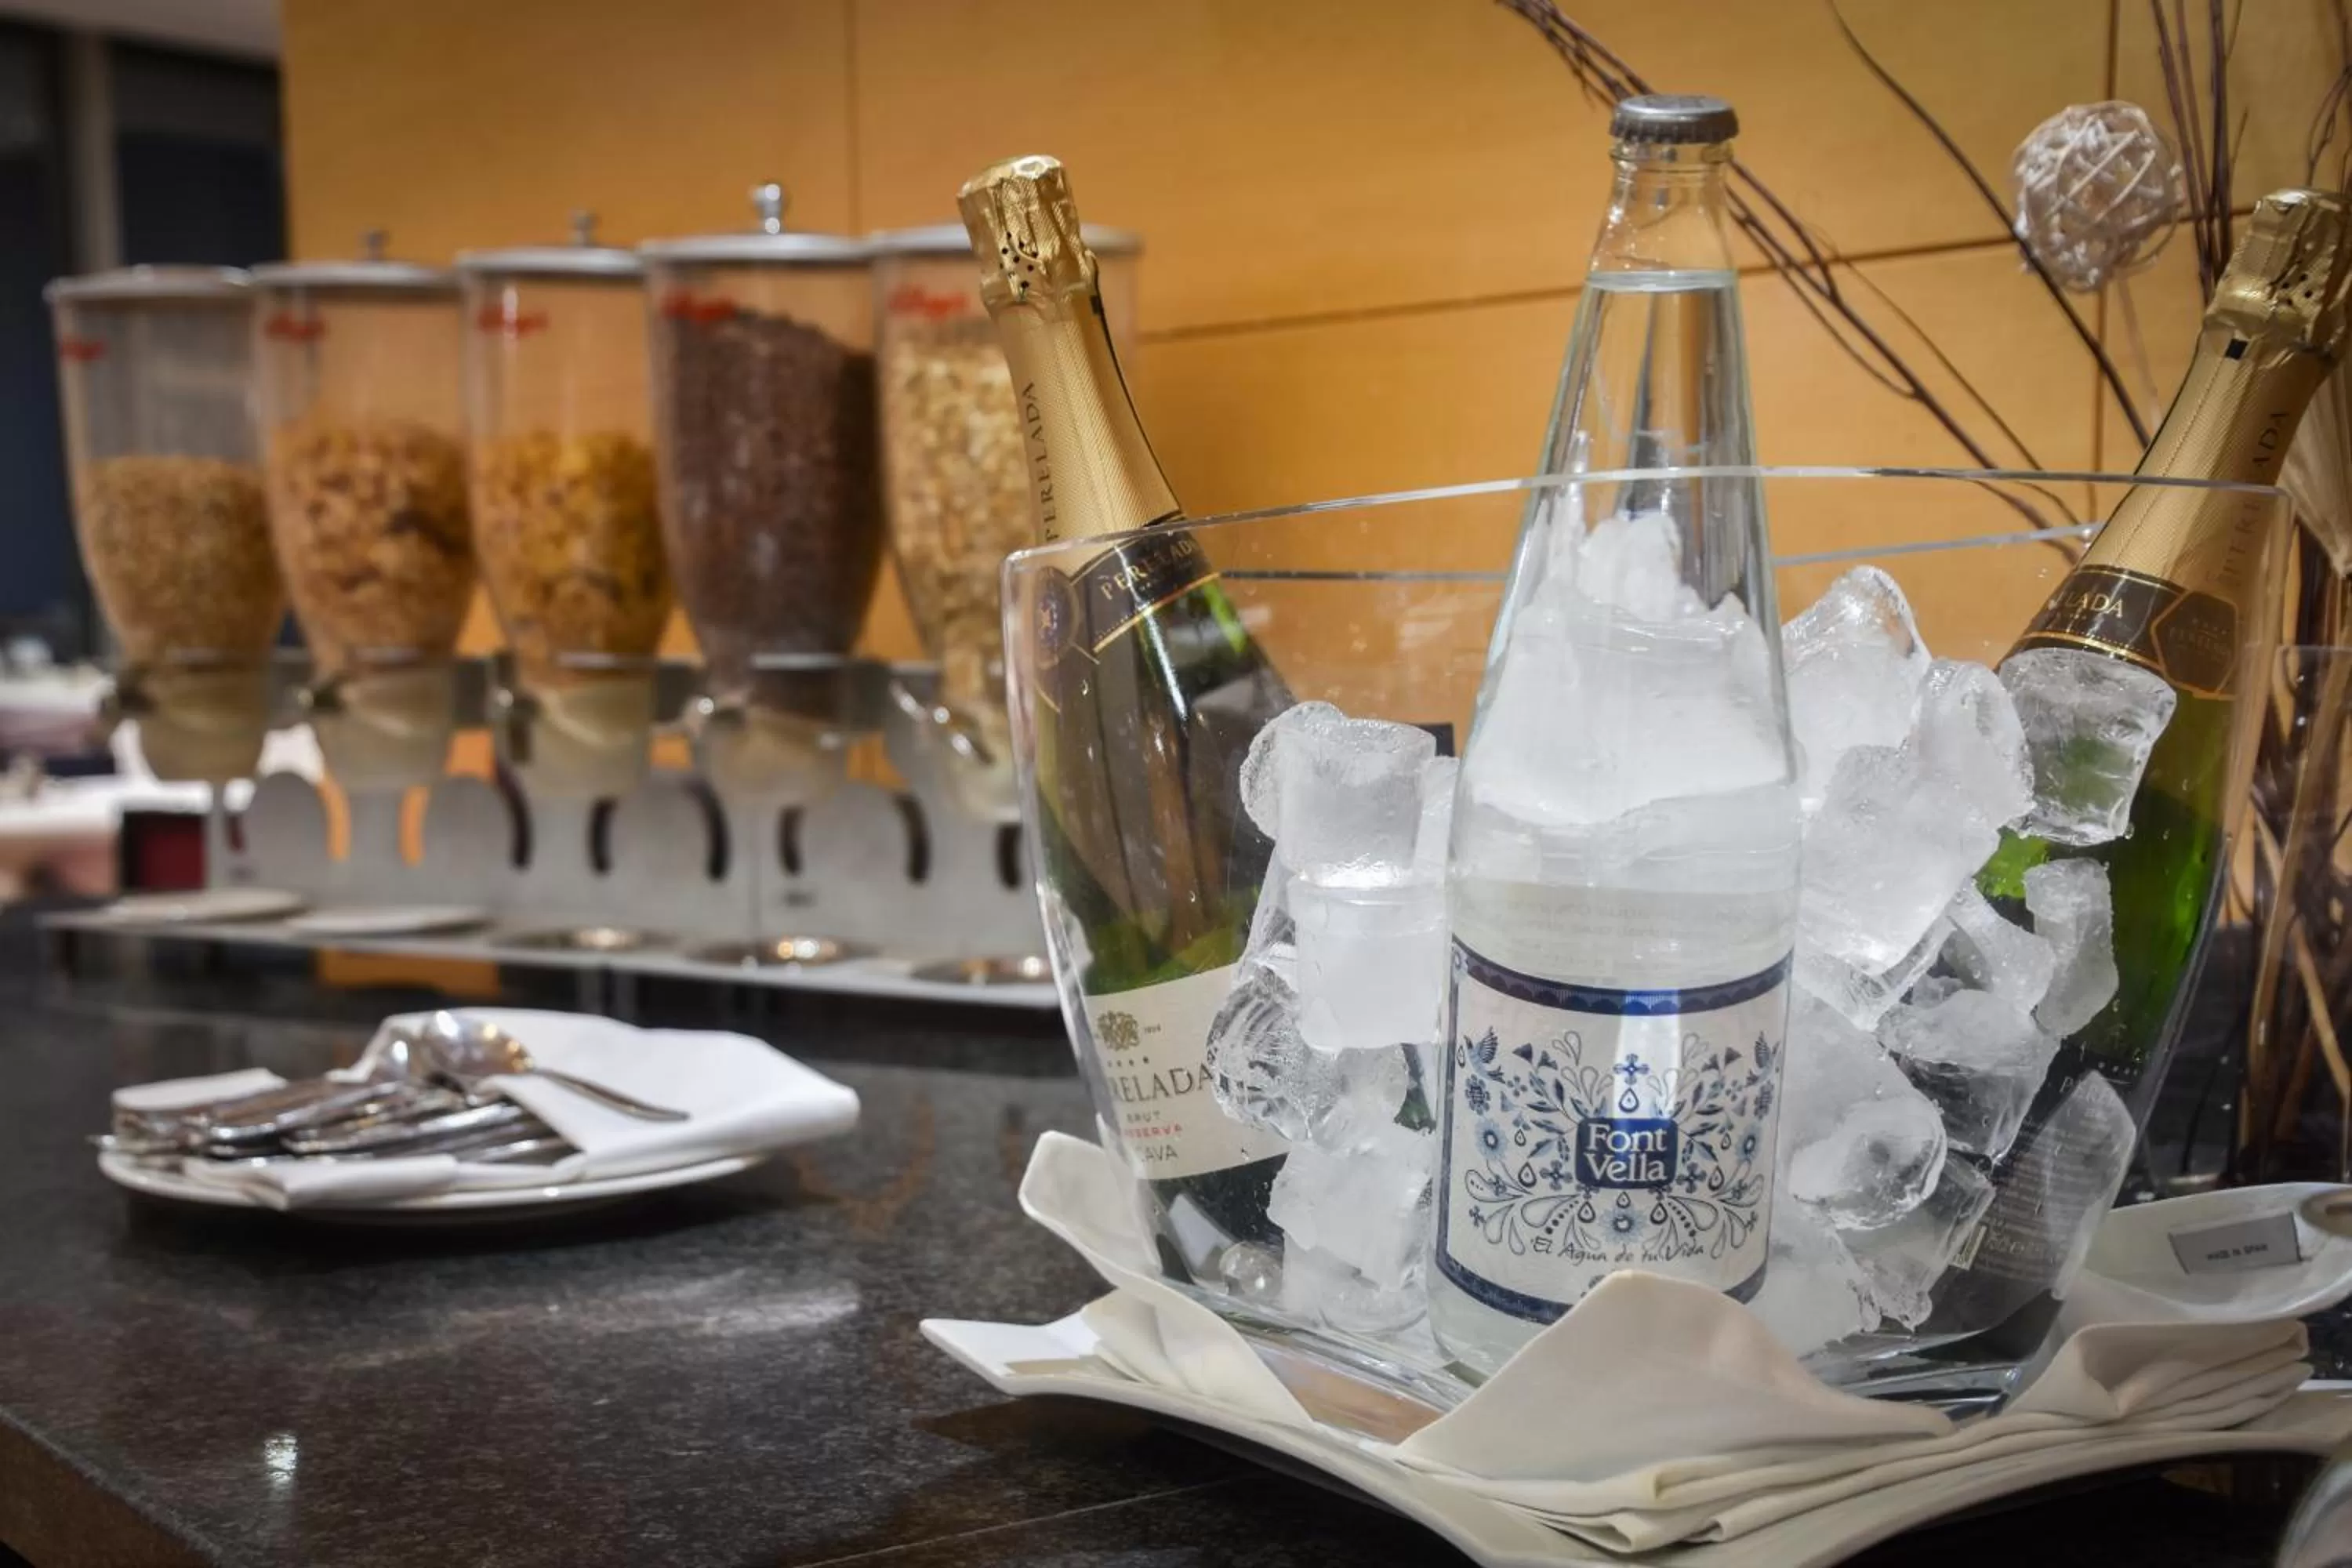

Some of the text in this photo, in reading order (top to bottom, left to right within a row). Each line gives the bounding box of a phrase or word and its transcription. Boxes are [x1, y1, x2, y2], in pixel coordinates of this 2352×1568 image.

[1022, 382, 1059, 542] PERELADA
[1586, 1123, 1668, 1152] Font
[1583, 1152, 1668, 1182] Vella
[1557, 1241, 1607, 1267] Agua
[1613, 1243, 1635, 1263] de
